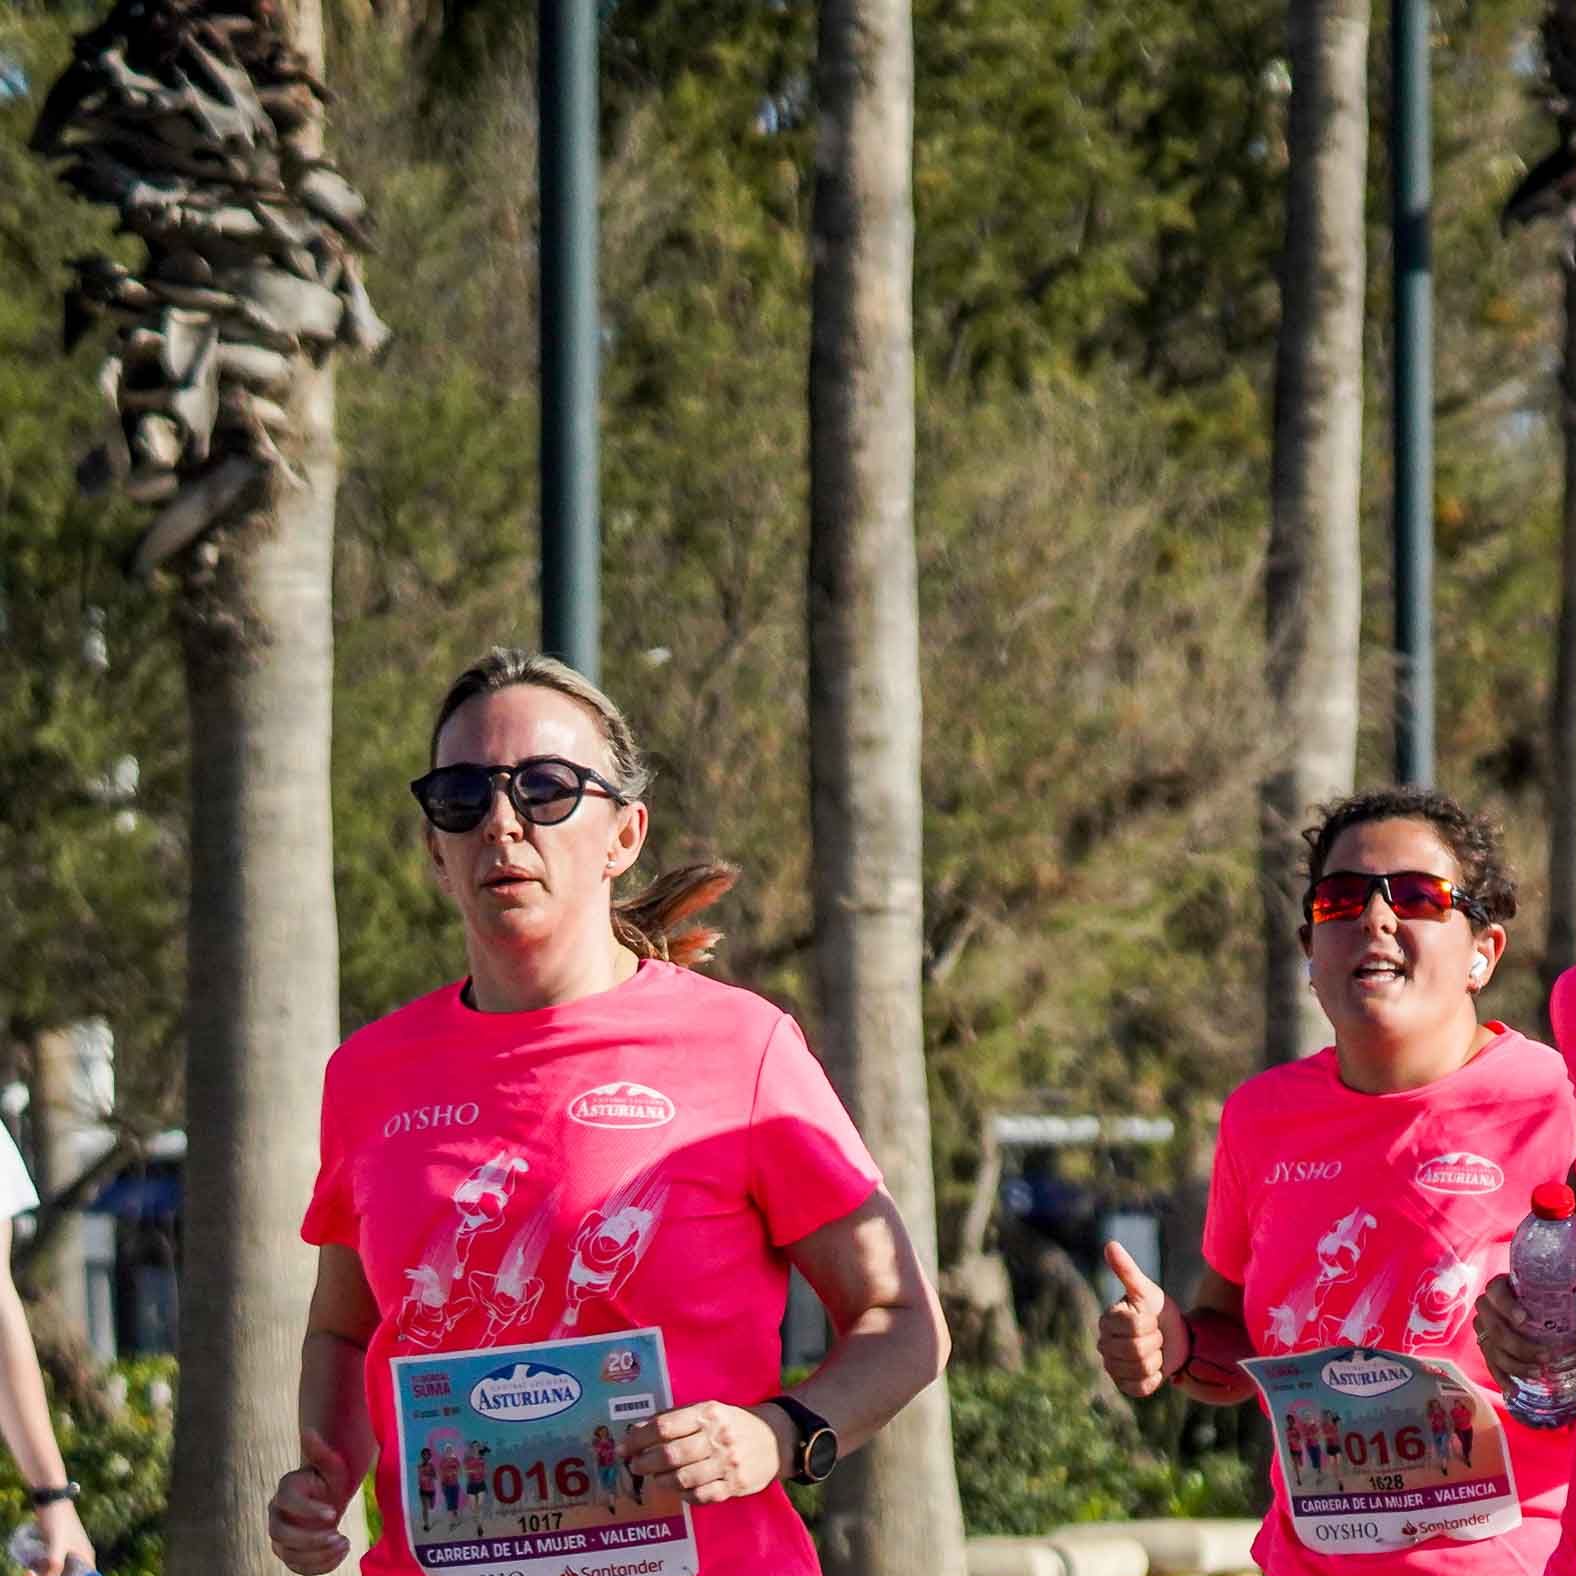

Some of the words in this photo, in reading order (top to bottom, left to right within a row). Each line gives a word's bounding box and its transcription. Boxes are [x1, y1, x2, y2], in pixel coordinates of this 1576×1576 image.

[384, 1102, 480, 1138] OYSHO
[576, 1100, 665, 1119] ASTURIANA
[1422, 1169, 1496, 1188] ASTURIANA
[606, 1352, 634, 1372] 20
[1328, 1368, 1409, 1386] ASTURIANA
[479, 1386, 575, 1411] ASTURIANA
[1344, 1426, 1426, 1466] 016
[493, 1457, 590, 1505] 016
[1369, 1474, 1405, 1491] 1628
[1301, 1497, 1350, 1513] CARRERA
[1353, 1496, 1367, 1510] DE
[1369, 1495, 1384, 1509] LA
[1385, 1493, 1424, 1509] MUJER
[1435, 1482, 1497, 1502] VALENCIA
[518, 1512, 562, 1533] 1017
[1316, 1521, 1379, 1541] OYSHO
[1418, 1512, 1491, 1534] Santander
[427, 1540, 490, 1564] CARRERA
[494, 1538, 512, 1557] DE
[515, 1536, 534, 1555] LA
[538, 1534, 587, 1553] MUJER
[600, 1523, 672, 1545] VALENCIA
